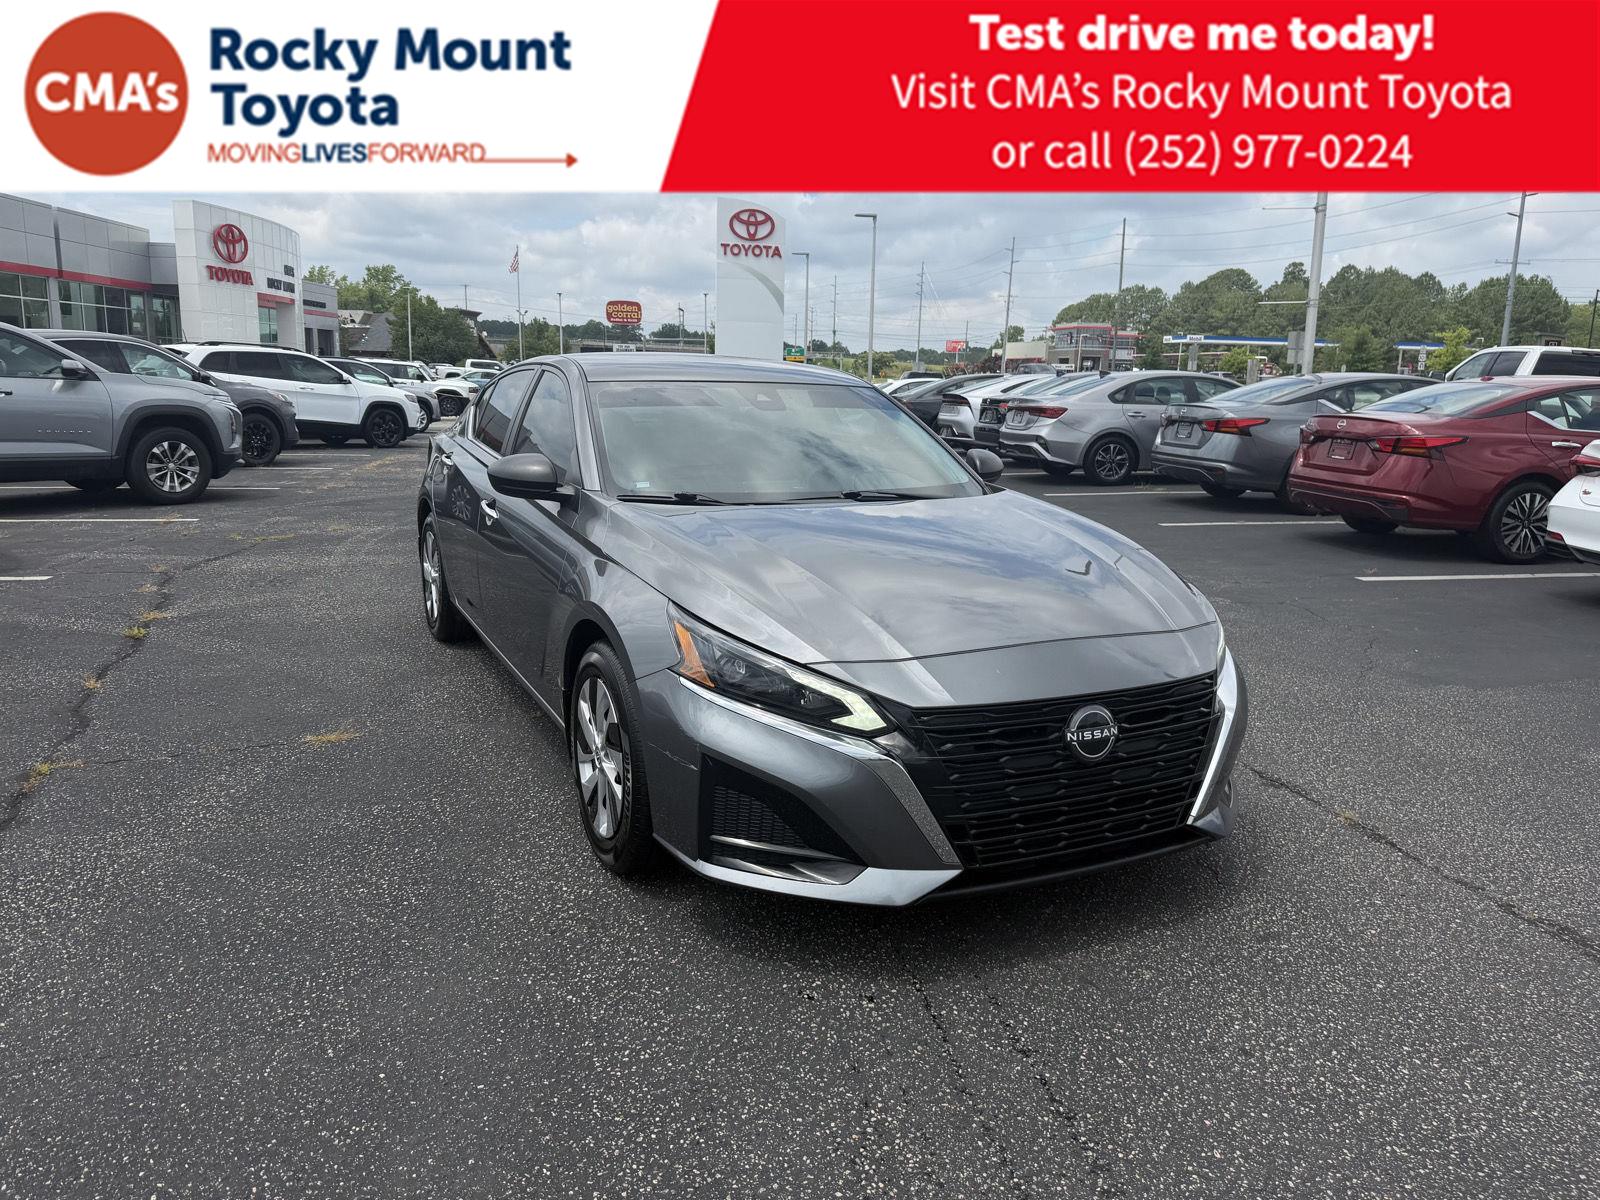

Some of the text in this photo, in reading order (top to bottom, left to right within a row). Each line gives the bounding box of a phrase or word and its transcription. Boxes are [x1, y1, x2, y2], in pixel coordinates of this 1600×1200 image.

[720, 243, 782, 259] TOYOTA
[206, 265, 254, 286] TOYOTA
[607, 304, 638, 313] golden
[611, 311, 641, 319] corral
[1067, 726, 1118, 741] NISSAN
